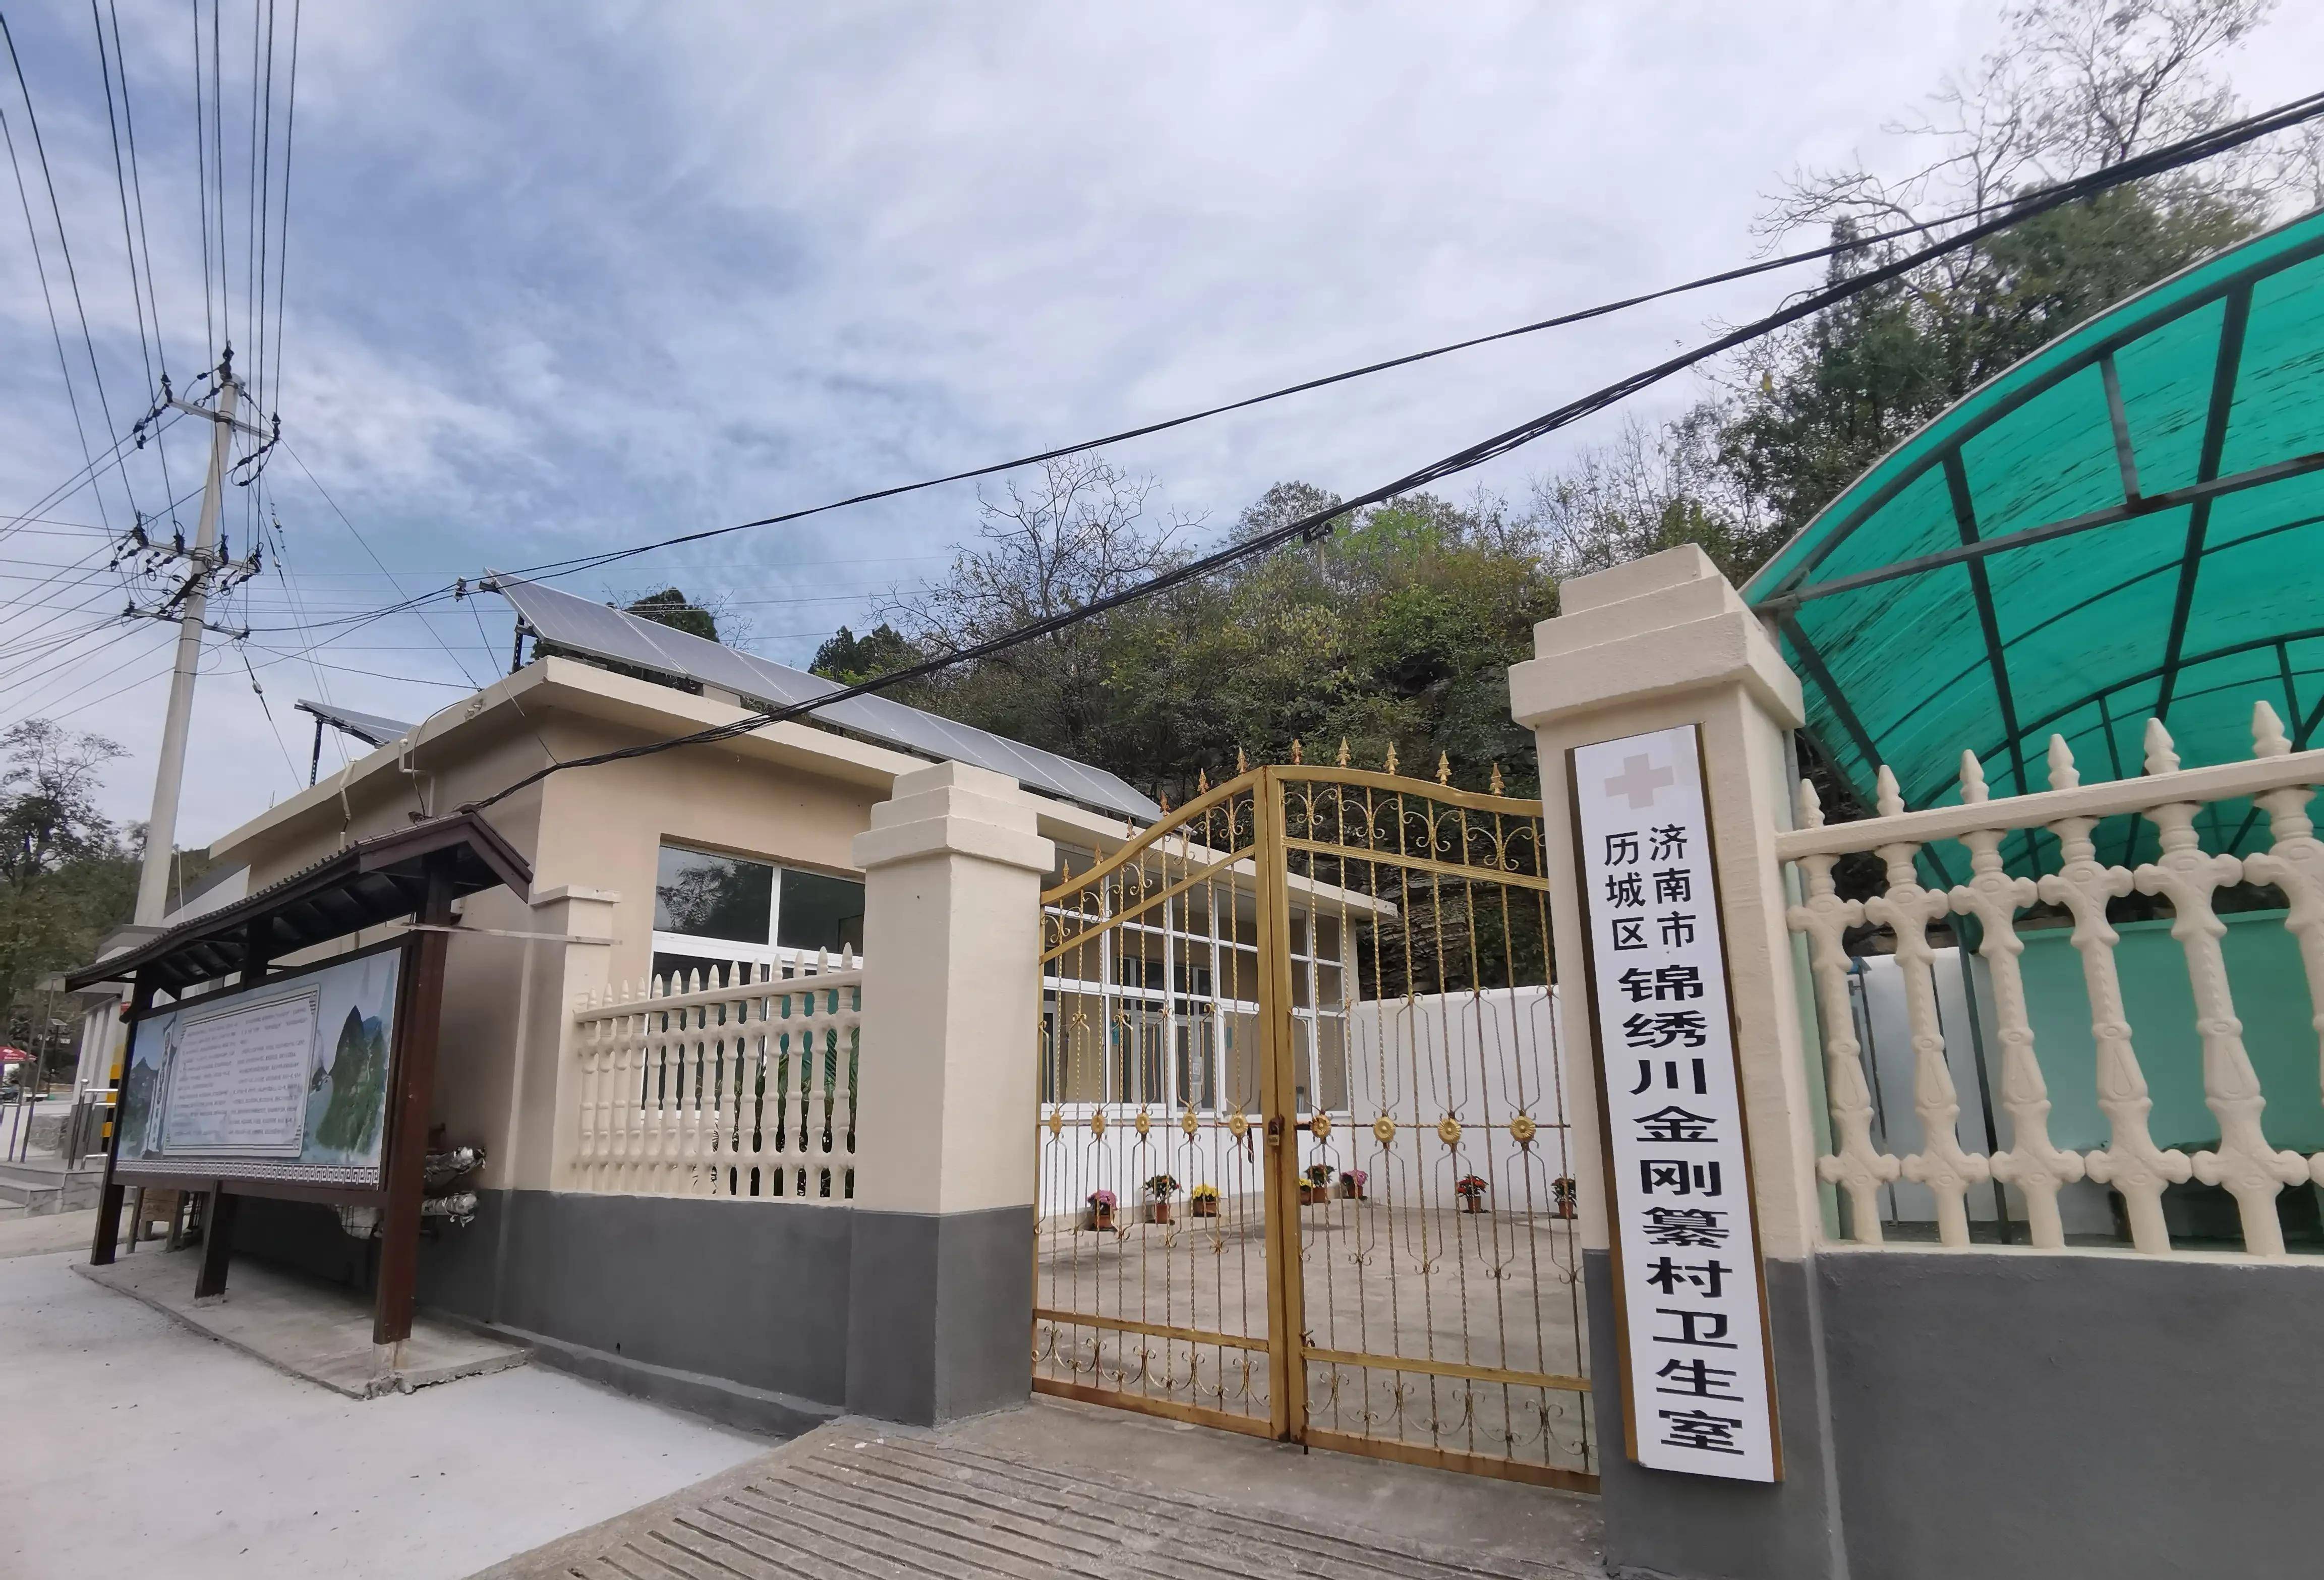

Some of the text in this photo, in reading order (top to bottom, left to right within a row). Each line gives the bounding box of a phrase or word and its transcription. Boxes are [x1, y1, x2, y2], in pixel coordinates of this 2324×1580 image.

[1604, 831, 1649, 952] 历城区
[1650, 823, 1696, 949] 济南市
[1617, 964, 1745, 1456] 锦绣川金刚纂村卫生室
